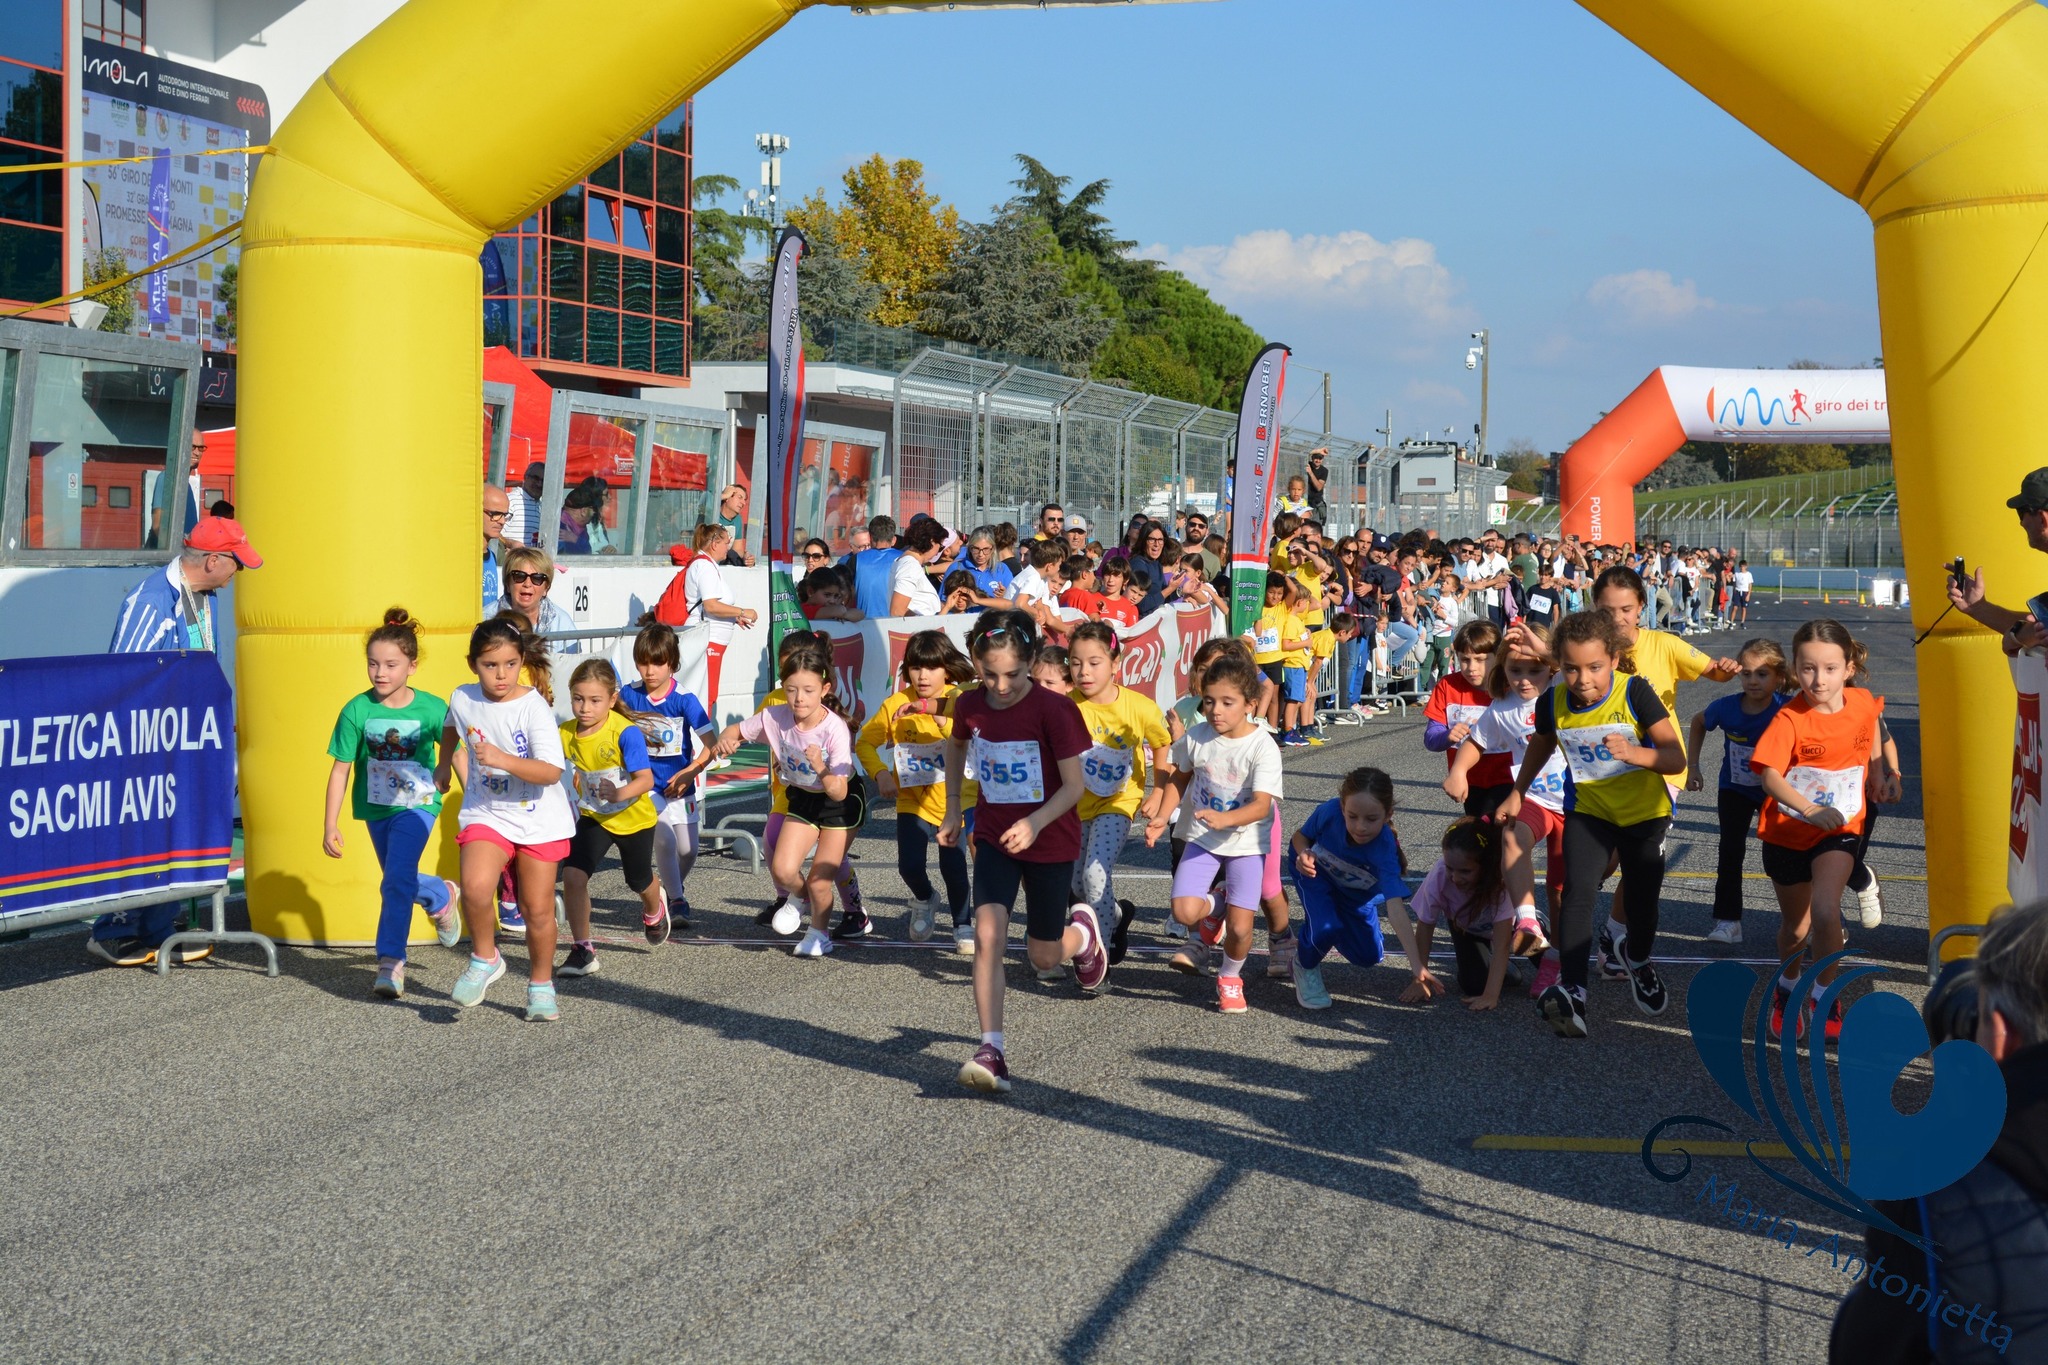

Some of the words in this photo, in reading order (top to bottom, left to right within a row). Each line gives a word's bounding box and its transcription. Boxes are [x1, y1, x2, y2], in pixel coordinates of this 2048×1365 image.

[83, 55, 148, 88] IMOLA
[158, 74, 189, 90] AUTODROMO
[190, 82, 229, 100] INTERNAZIONALE
[158, 85, 171, 95] ENZO
[176, 89, 189, 99] DINO
[190, 92, 210, 104] FERRARI
[121, 168, 140, 184] GIRO
[141, 172, 151, 187] DE
[137, 194, 148, 206] GRA
[105, 203, 146, 224] PROMESSE
[787, 308, 798, 336] 672176
[1256, 360, 1271, 441] BERNABEI
[1815, 400, 1842, 414] giro
[1847, 399, 1869, 411] dei
[1874, 400, 1887, 411] tr
[1590, 496, 1602, 541] POWER
[575, 585, 588, 612] 26
[1257, 635, 1276, 646] 596
[1122, 640, 1160, 687] CLAI
[0, 711, 123, 768] TLETICA
[130, 706, 222, 755] IMOLA
[907, 753, 945, 772] 561
[1577, 743, 1613, 764] 56
[980, 759, 1028, 784] 555
[1085, 757, 1126, 782] 553
[1530, 769, 1566, 794] 55
[481, 774, 509, 792] 251
[9, 780, 111, 839] SACMI
[119, 772, 176, 824] AVIS
